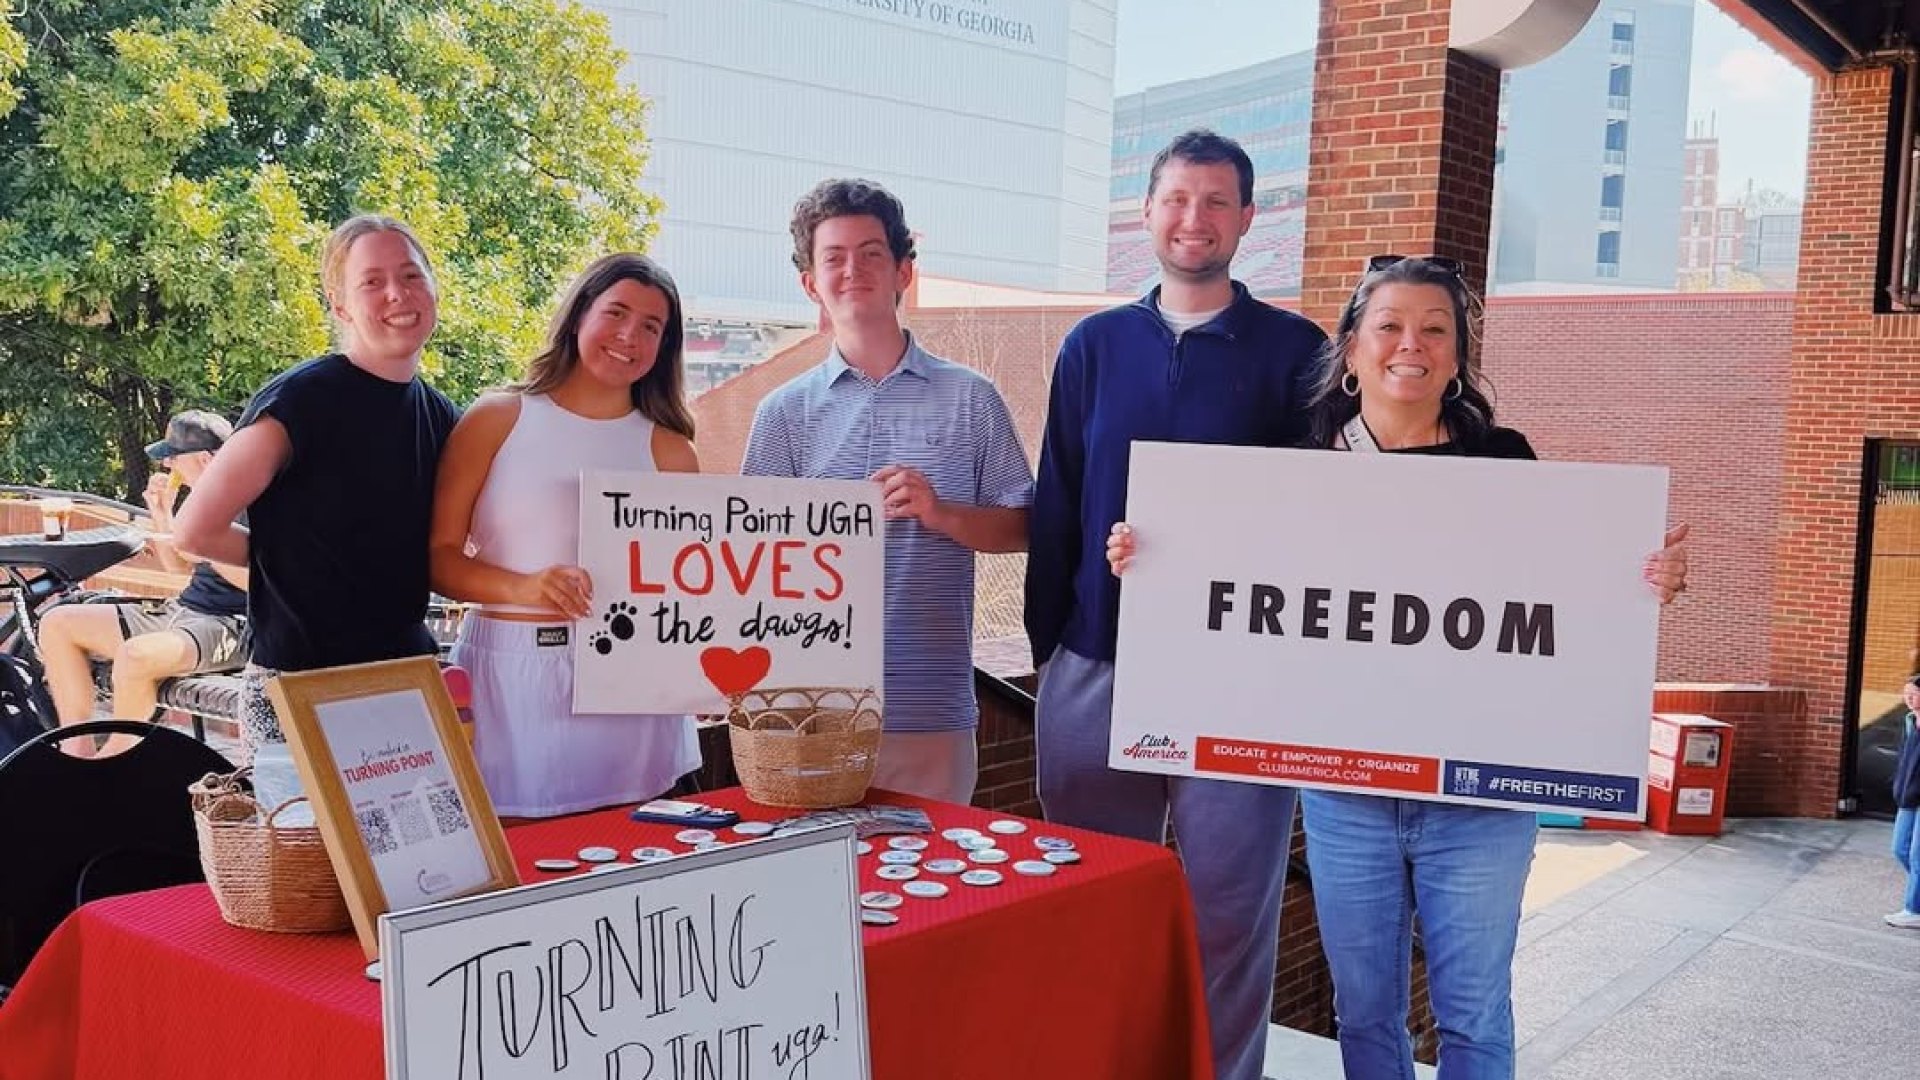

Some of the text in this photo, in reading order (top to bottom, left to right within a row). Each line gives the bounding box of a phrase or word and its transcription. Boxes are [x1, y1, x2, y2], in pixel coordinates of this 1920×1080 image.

[929, 3, 953, 23] OF
[957, 8, 1035, 44] GEORGIA
[602, 491, 873, 544] Turning Point UGA
[628, 540, 844, 601] LOVES
[650, 601, 852, 649] the dawgs!
[1206, 580, 1555, 657] FREEDOM
[1123, 742, 1188, 759] America
[1140, 733, 1170, 747] Club
[1213, 743, 1420, 775] EDUCATE EMPOWER ORGANIZE
[343, 758, 400, 784] TURNING
[400, 750, 436, 771] POINT
[1258, 761, 1372, 782] CLUBAMERICA.COM
[1488, 777, 1626, 803] #FREETHEFIRST
[427, 892, 776, 1080] TURNING
[771, 991, 840, 1080] uga!
